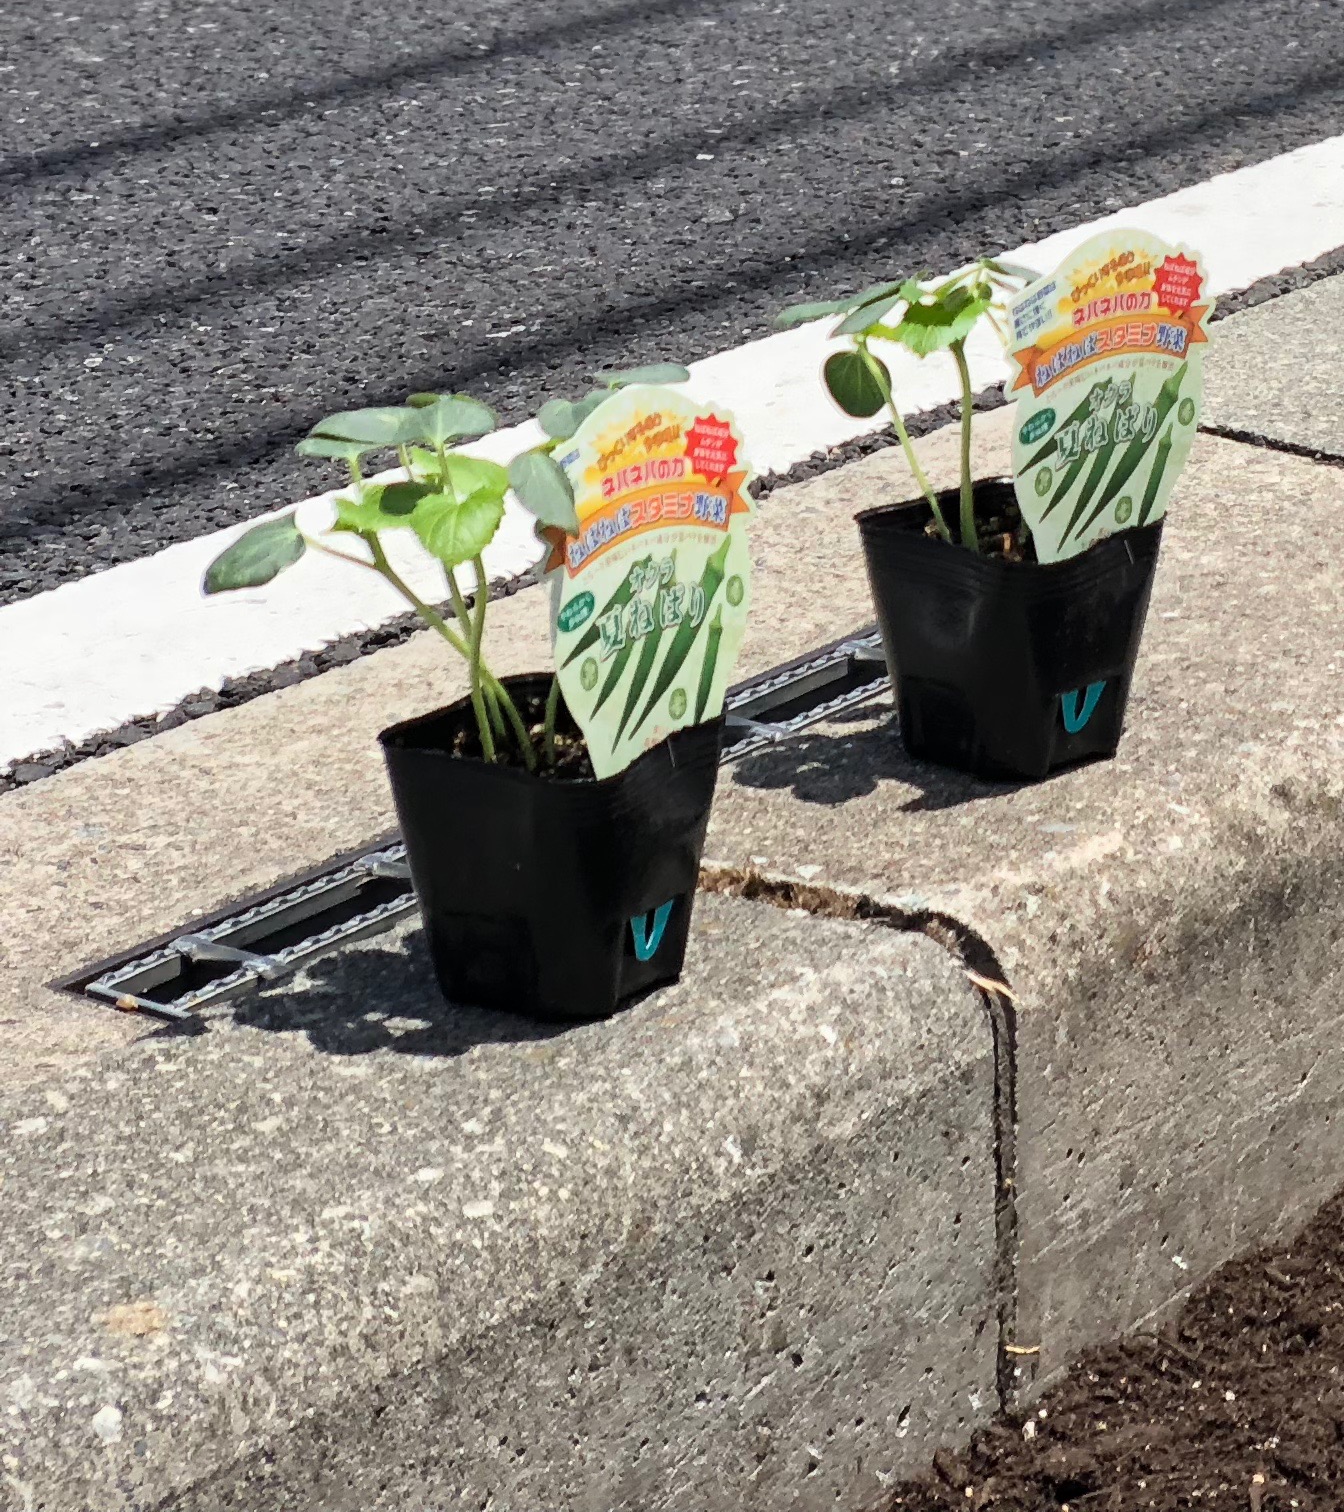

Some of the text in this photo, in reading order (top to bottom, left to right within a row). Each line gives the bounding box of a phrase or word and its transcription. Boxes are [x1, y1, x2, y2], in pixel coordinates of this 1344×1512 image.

[1073, 291, 1152, 326] ネバネバの力
[1035, 322, 1187, 387] ねばねばスタミナ野菜
[1089, 380, 1131, 411] オクラ
[601, 457, 686, 499] ネバネバの力
[568, 492, 728, 568] ねばねばスタミナ野菜
[629, 557, 675, 593] オクラ
